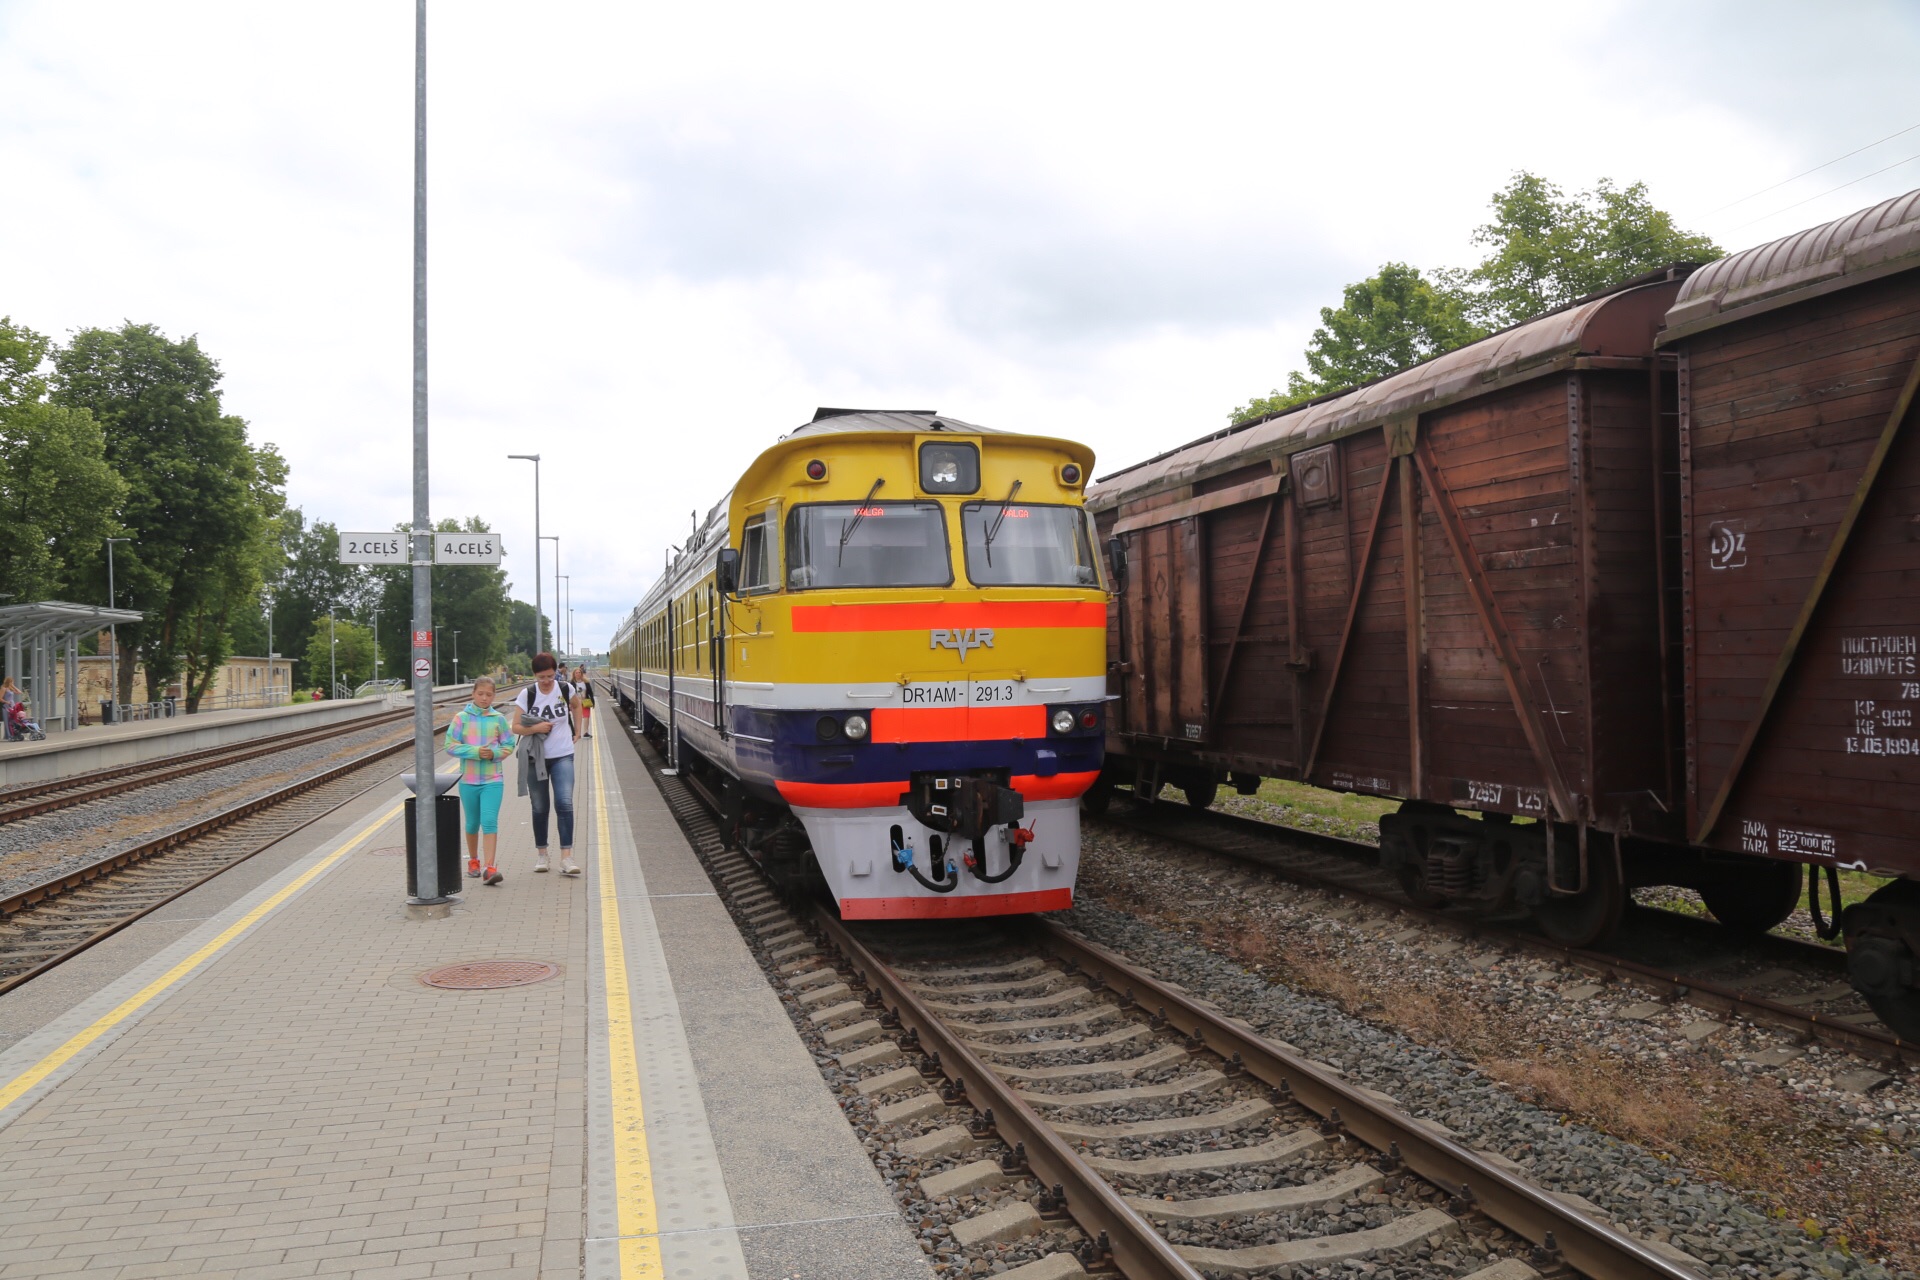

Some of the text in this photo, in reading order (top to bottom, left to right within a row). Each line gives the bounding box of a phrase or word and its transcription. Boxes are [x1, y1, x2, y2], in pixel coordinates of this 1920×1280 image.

[348, 539, 399, 557] 2.CEĻŠ
[444, 540, 493, 557] 4.CEĻŠ
[930, 628, 994, 664] RVR
[976, 685, 1013, 702] 291.3
